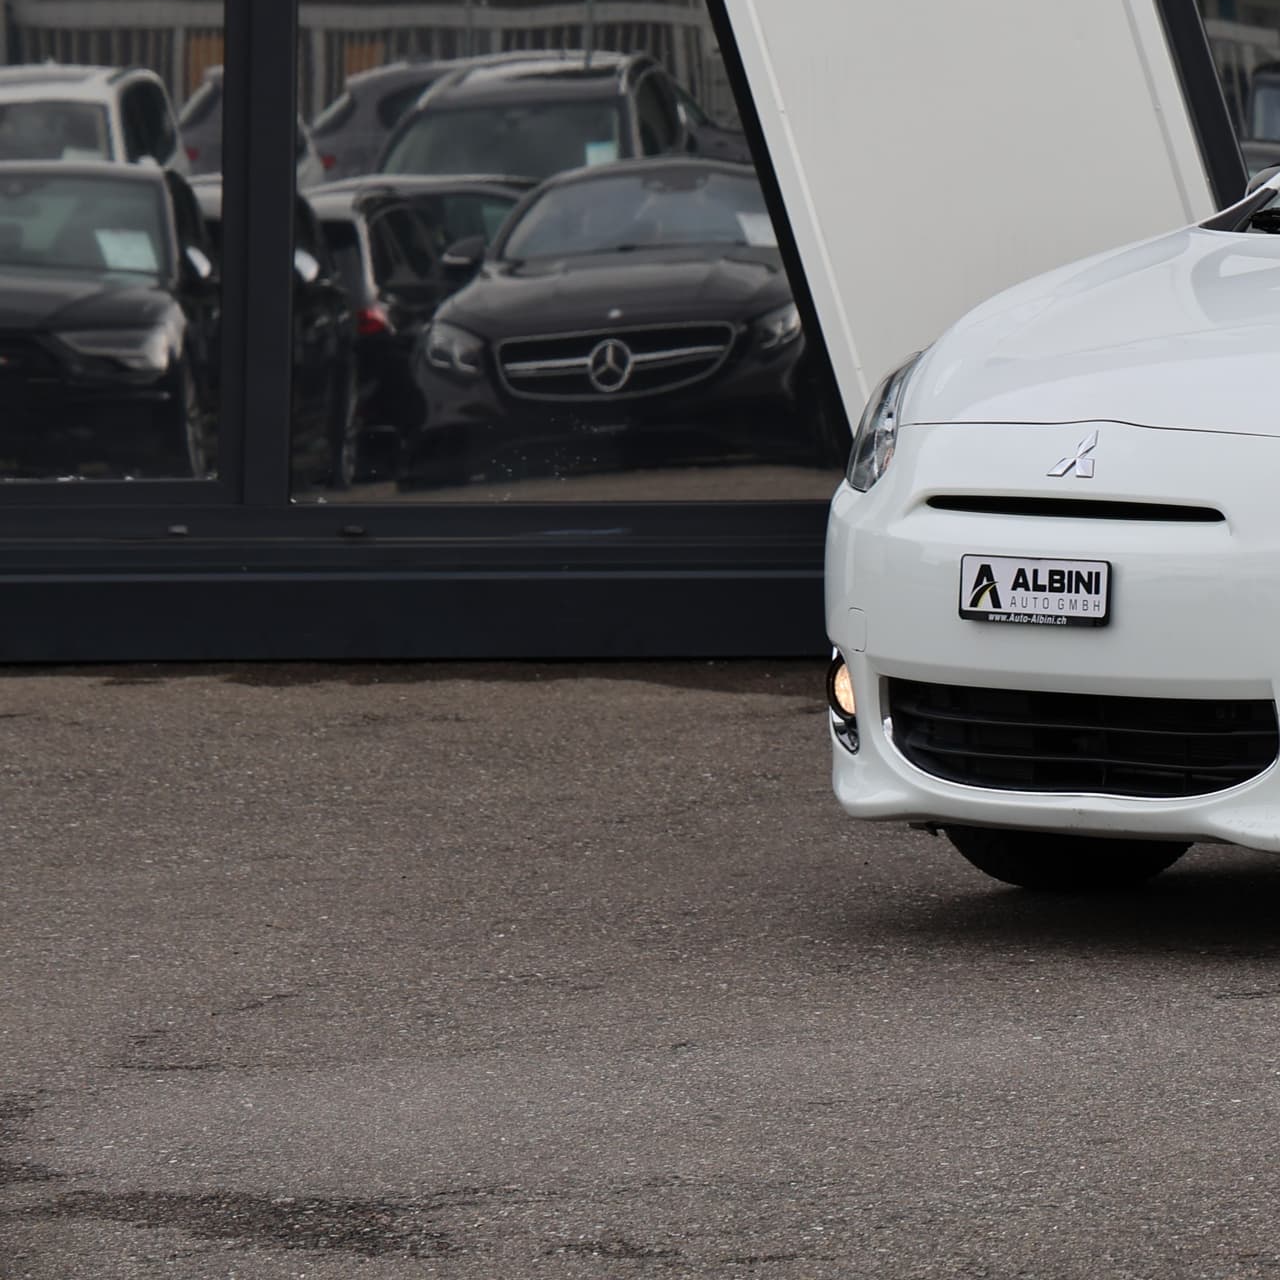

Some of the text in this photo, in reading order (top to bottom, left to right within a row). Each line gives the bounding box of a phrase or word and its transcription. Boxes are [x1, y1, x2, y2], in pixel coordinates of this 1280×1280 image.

[1010, 567, 1101, 595] ALBINI
[1009, 596, 1101, 612] AUTO GMBH
[987, 612, 1067, 625] www.Auto-Albini.ch
